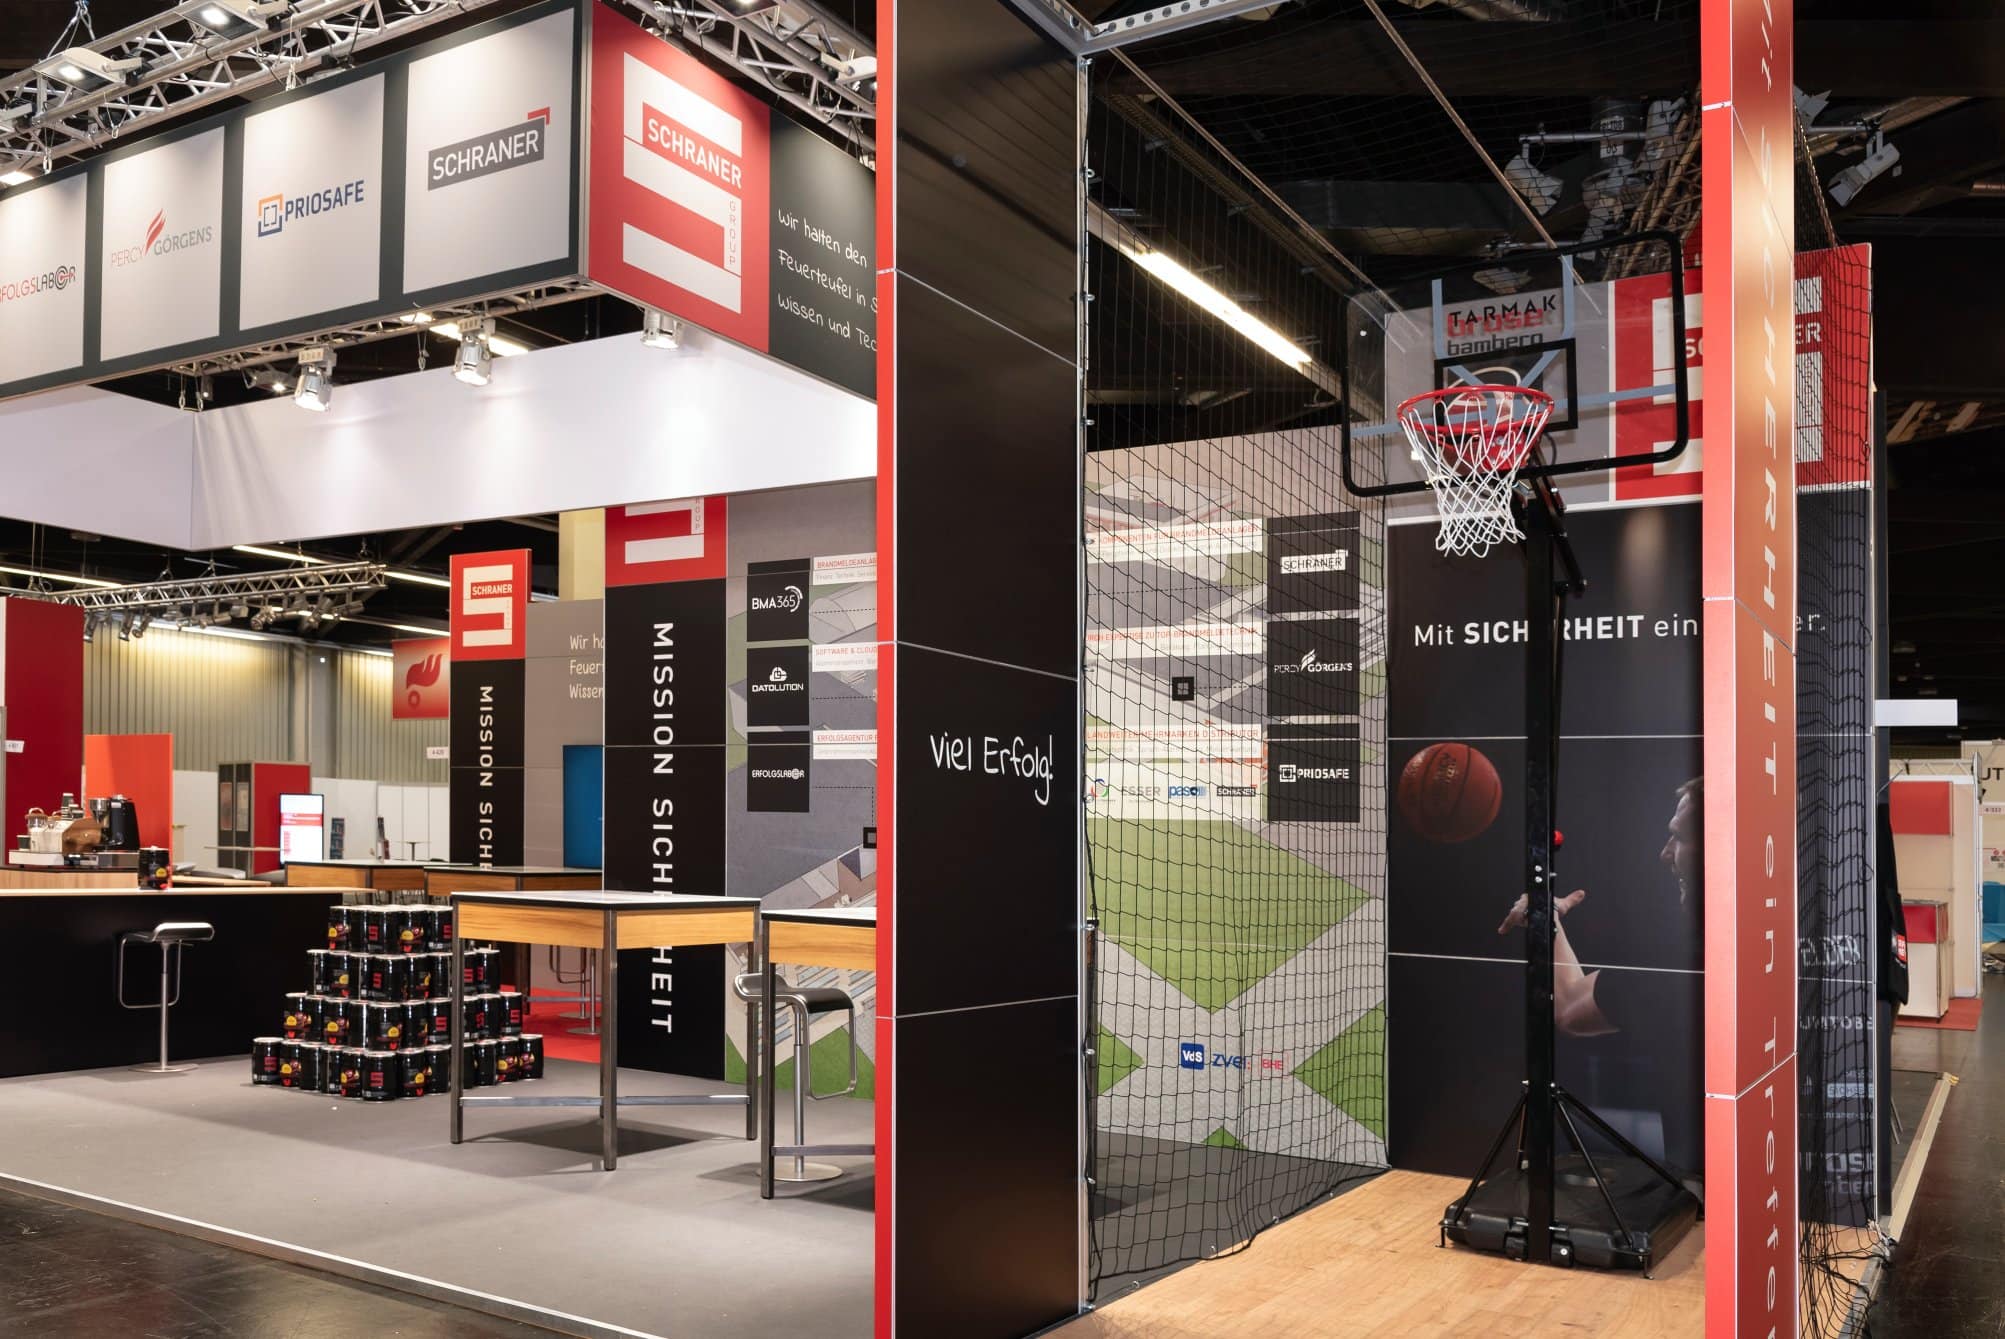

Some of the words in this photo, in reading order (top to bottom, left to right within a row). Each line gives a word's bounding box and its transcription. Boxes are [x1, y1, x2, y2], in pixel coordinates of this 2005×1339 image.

[432, 129, 540, 181] SCHRANER
[648, 117, 742, 190] SCHRANER
[284, 179, 365, 222] PRIOSAFE
[111, 245, 145, 268] PERCY
[153, 225, 213, 256] GÖRGENS
[729, 200, 737, 266] GROUP
[778, 208, 799, 231] Wir
[804, 217, 841, 254] halten
[845, 242, 868, 269] den
[0, 265, 76, 304] FOLGSLABOR
[777, 248, 851, 300] Feuerteufel
[856, 288, 866, 308] in
[778, 292, 824, 327] Wissen
[828, 317, 850, 339] und
[1450, 294, 1557, 328] TARMAK
[1283, 557, 1343, 571] SCHRANER
[471, 583, 513, 597] SCHRANER
[751, 594, 797, 610] BMA365
[569, 634, 588, 650] Wir
[1414, 623, 1455, 648] Mit
[1463, 614, 1645, 645] SICHRHEIT
[1654, 615, 1698, 637] ein
[652, 622, 674, 775] MISSION
[751, 683, 804, 693] DATOLUTION
[479, 685, 494, 787] MISSION
[751, 768, 805, 780] ERFOLGSLABOR
[929, 731, 972, 772] Viel
[983, 733, 1054, 806] Erfolg!
[1296, 767, 1350, 780] PRIOSAFE
[1765, 834, 1776, 974] ein
[1181, 1050, 1203, 1064] VdS
